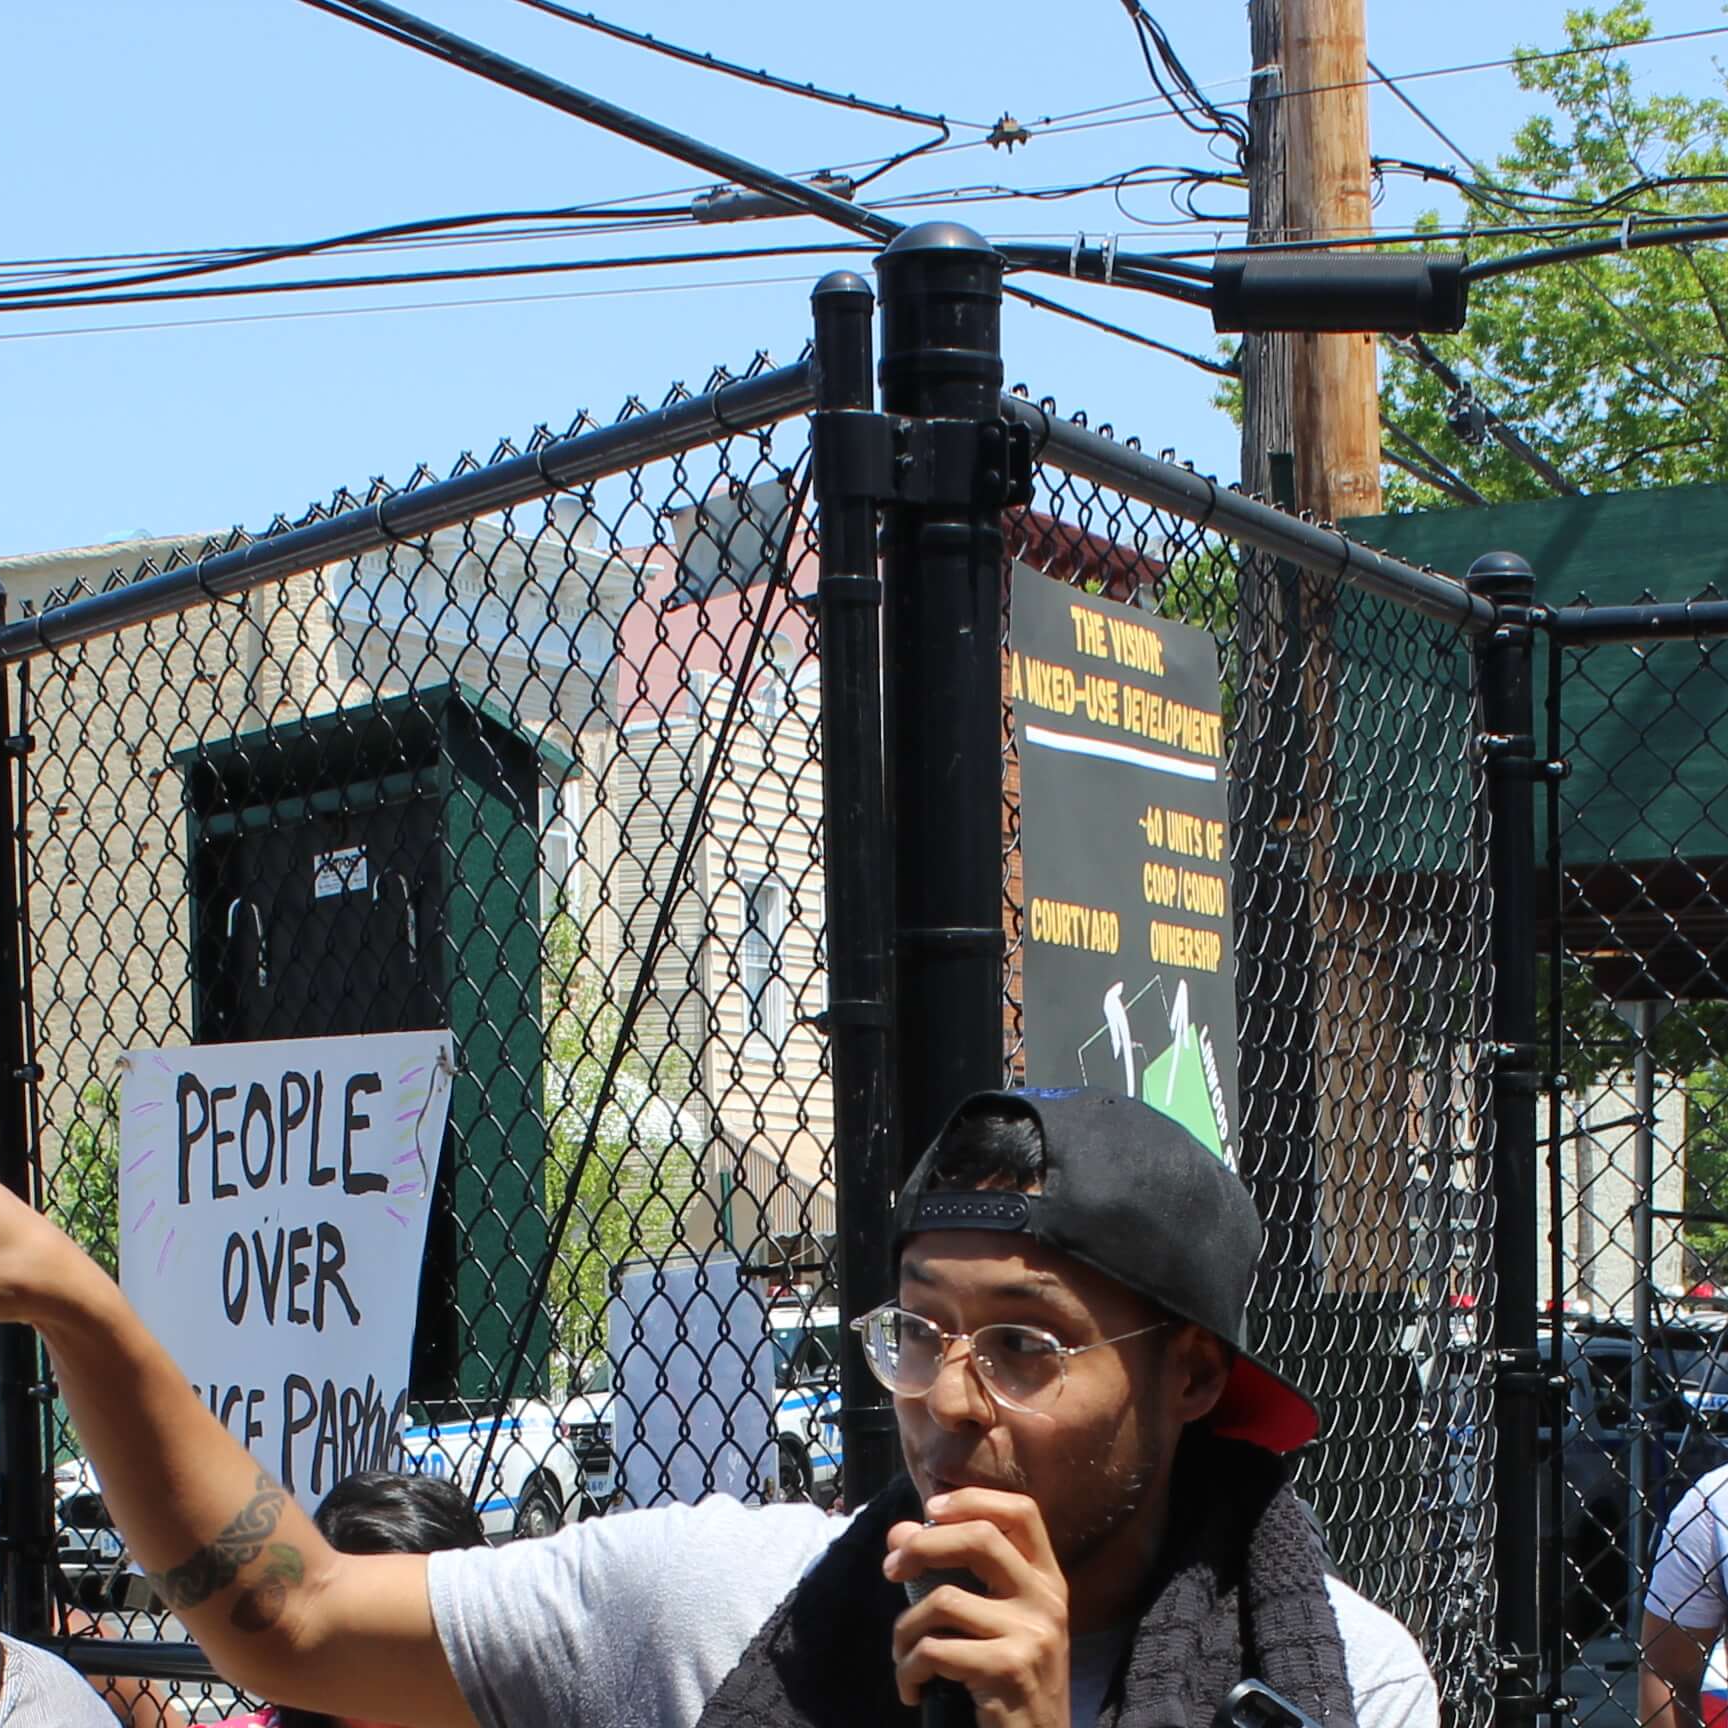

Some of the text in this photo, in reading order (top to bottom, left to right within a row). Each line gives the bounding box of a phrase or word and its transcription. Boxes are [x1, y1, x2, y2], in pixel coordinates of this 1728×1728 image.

[1070, 605, 1165, 677] THE VISION:
[1011, 651, 1221, 758] A MIXED-USE DEVELOPMENT
[1166, 810, 1203, 858] UNITS
[1206, 820, 1223, 862] OF
[1031, 898, 1120, 955] COURTYARD
[1150, 920, 1221, 973] OWNERSHIP
[176, 1071, 390, 1205] PEOPLE
[223, 1220, 361, 1332] OVER
